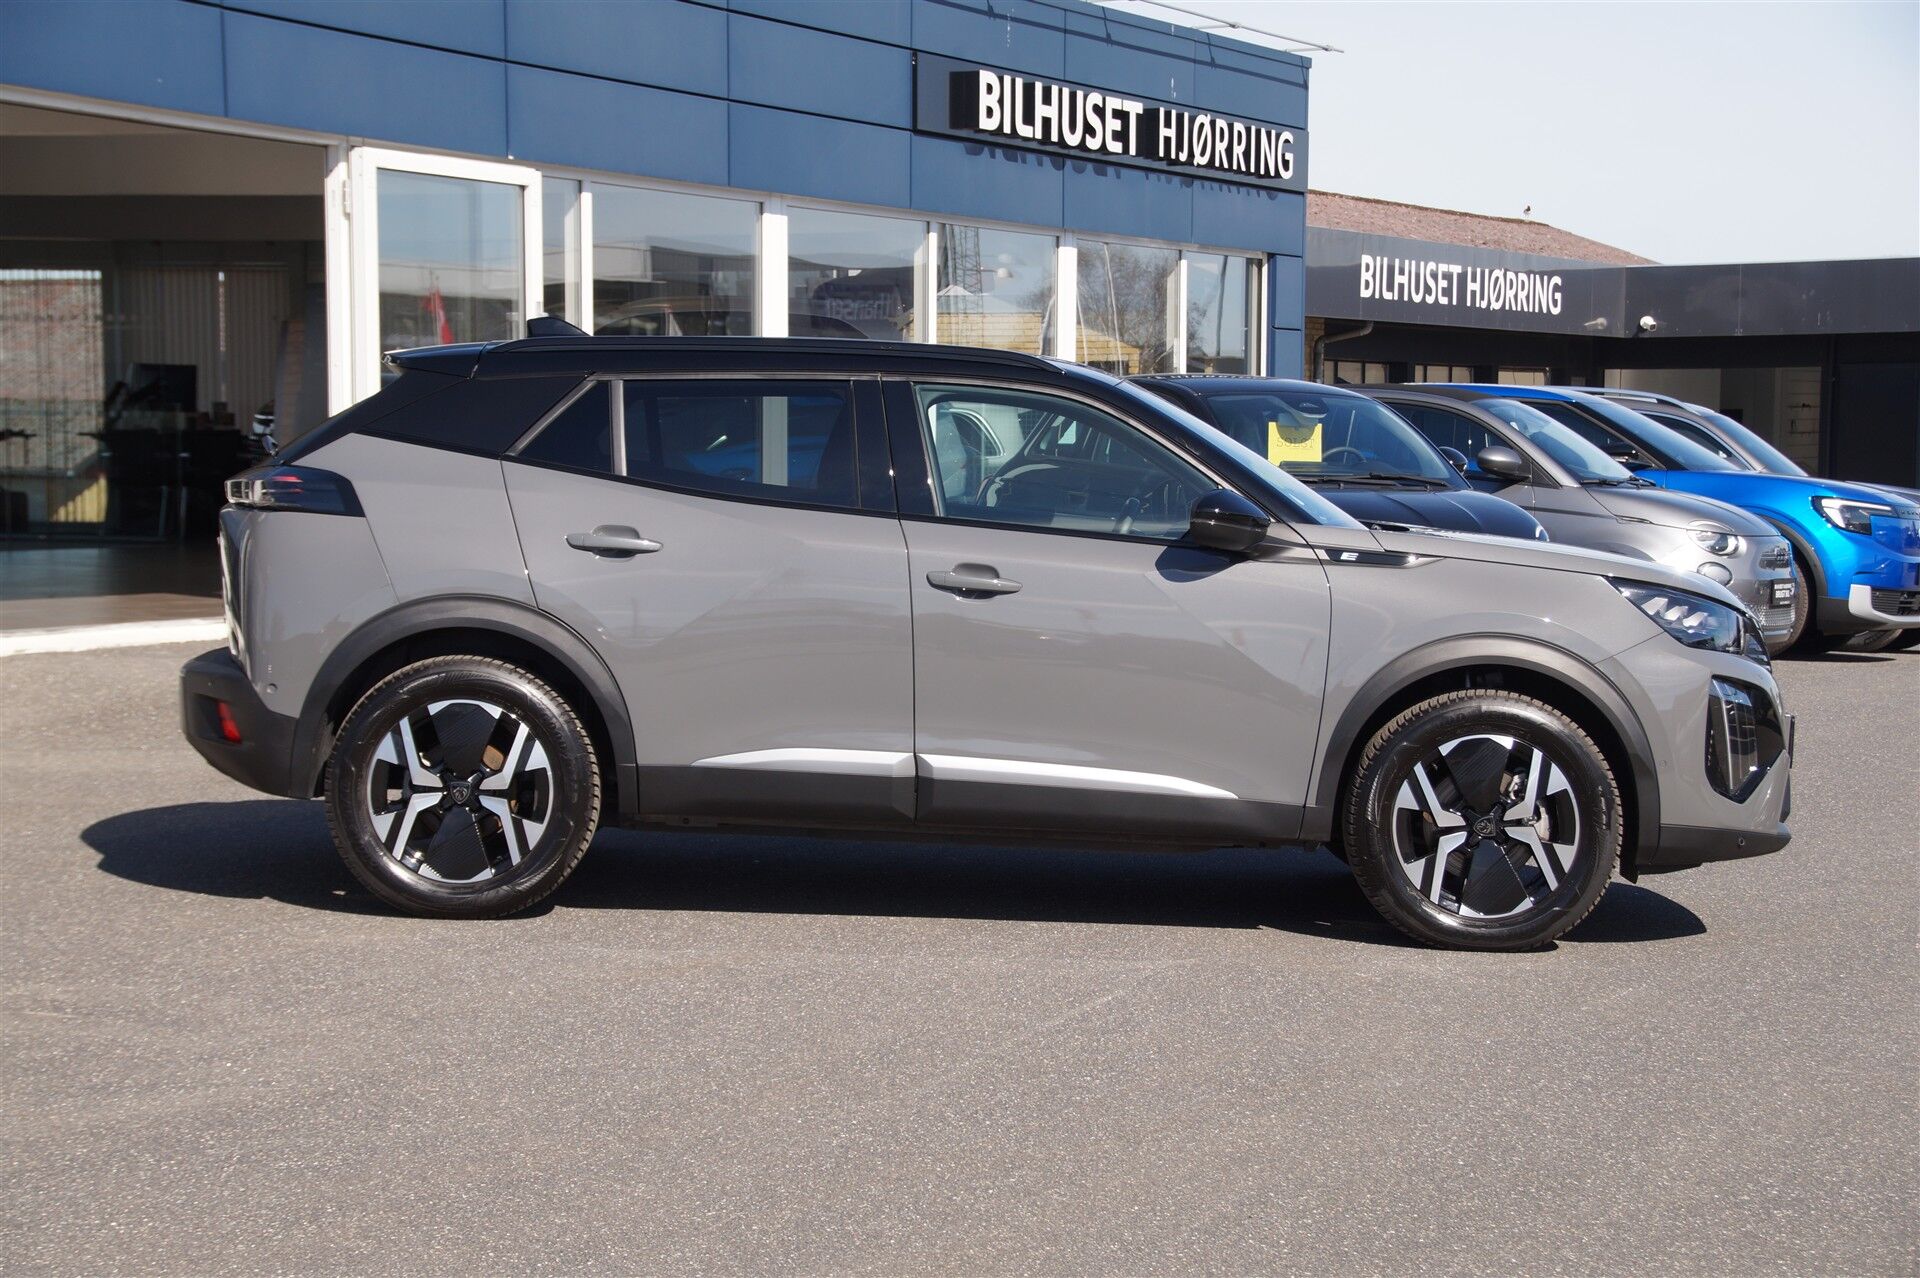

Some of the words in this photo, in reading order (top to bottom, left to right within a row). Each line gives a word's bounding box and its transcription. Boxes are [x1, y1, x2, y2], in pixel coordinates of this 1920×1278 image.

[978, 69, 1143, 156] BILHUSET
[1158, 106, 1294, 179] HJØRRING
[1360, 254, 1462, 305] BILHUSET
[1466, 266, 1562, 315] HJØRRING
